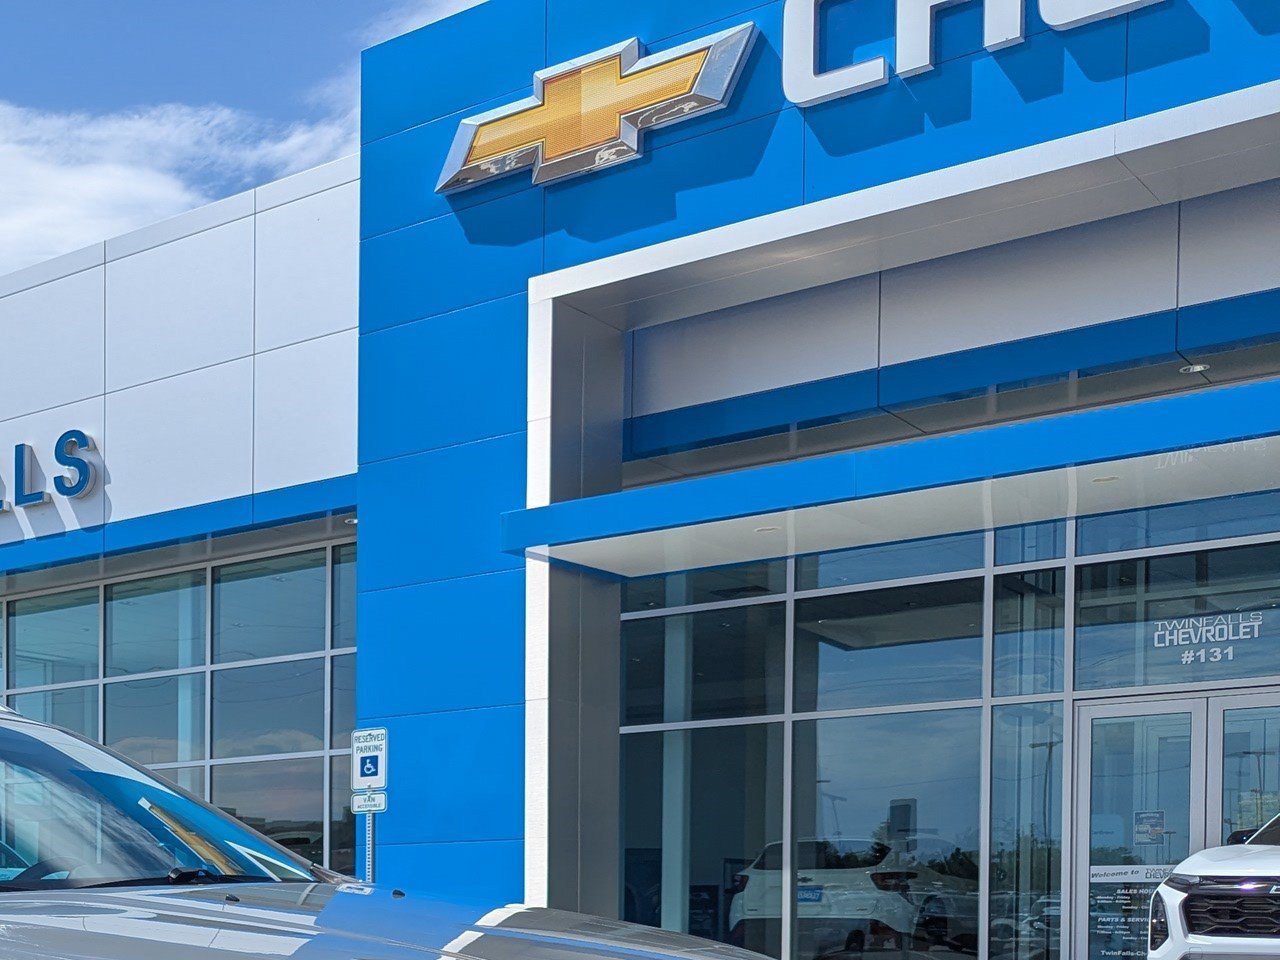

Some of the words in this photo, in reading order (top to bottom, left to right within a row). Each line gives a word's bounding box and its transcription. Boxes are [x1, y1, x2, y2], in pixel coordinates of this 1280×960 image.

[1153, 621, 1263, 648] CHEVROLET
[1181, 646, 1234, 665] #131
[354, 732, 385, 744] RESERVED
[356, 744, 383, 754] PARKING
[1091, 870, 1129, 879] Welcome
